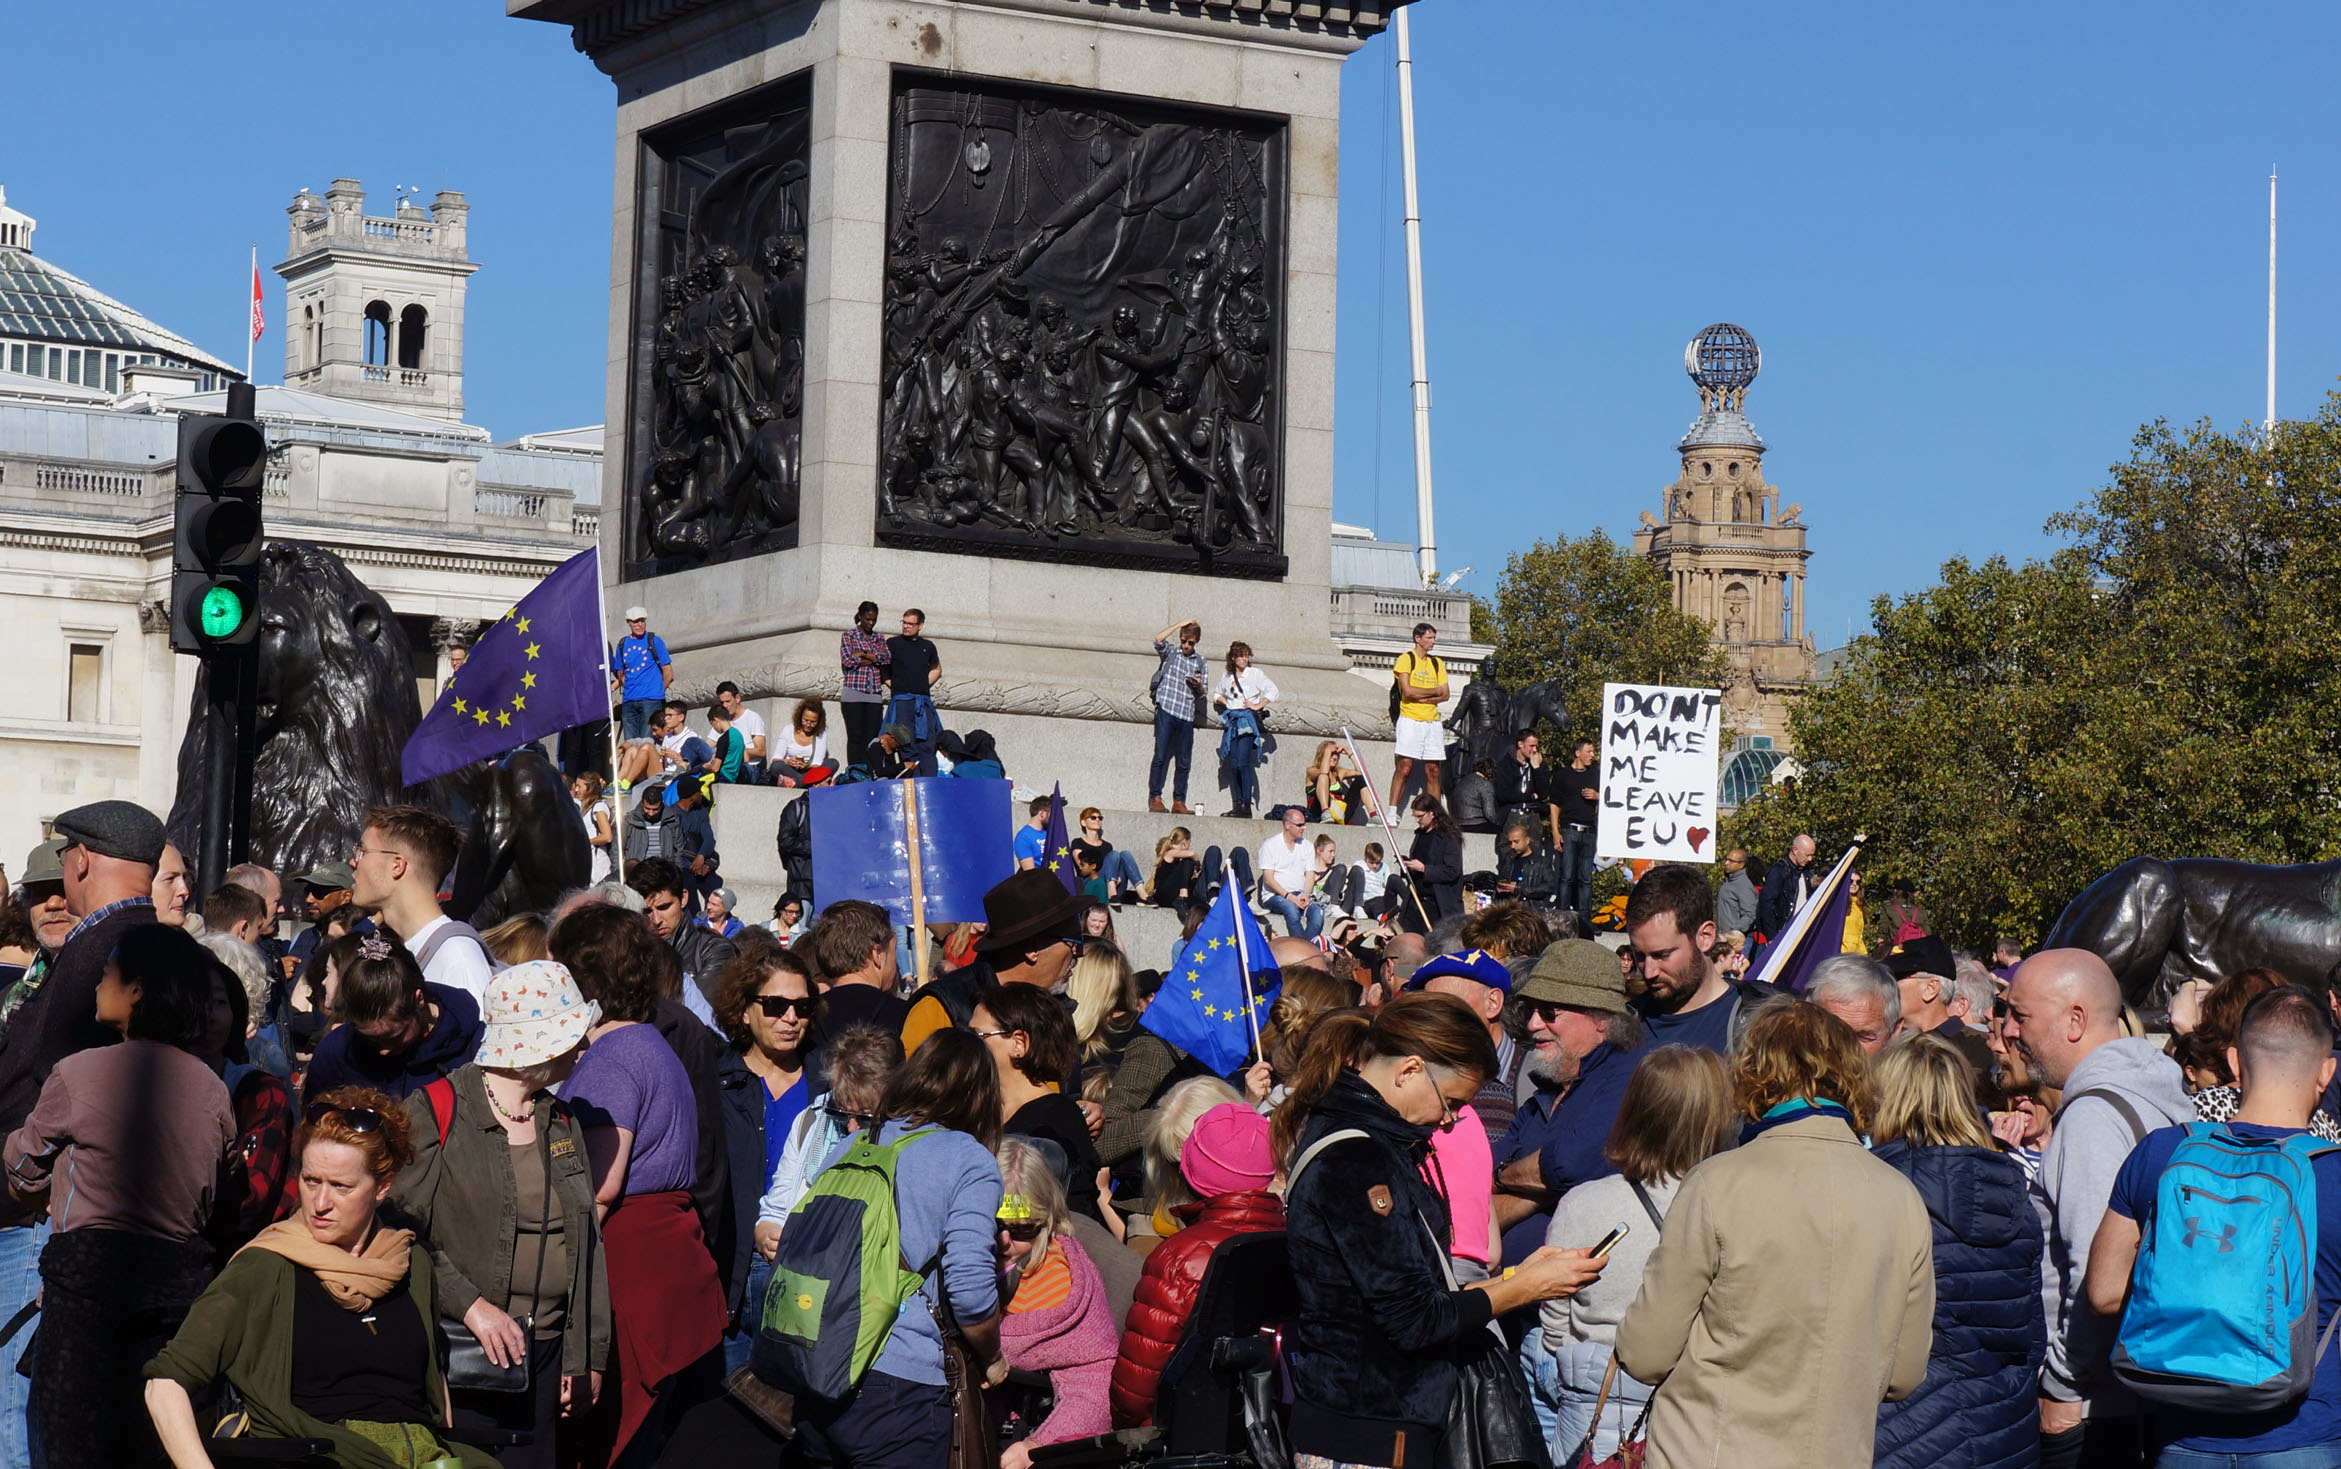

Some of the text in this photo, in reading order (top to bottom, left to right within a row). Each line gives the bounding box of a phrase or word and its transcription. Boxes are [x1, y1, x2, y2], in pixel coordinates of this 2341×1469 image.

[1609, 719, 1705, 753] MAKE
[1609, 755, 1657, 783] ME
[1604, 786, 1705, 816] LEAVE
[1626, 816, 1677, 849] EU
[2266, 1217, 2283, 1277] UNDER
